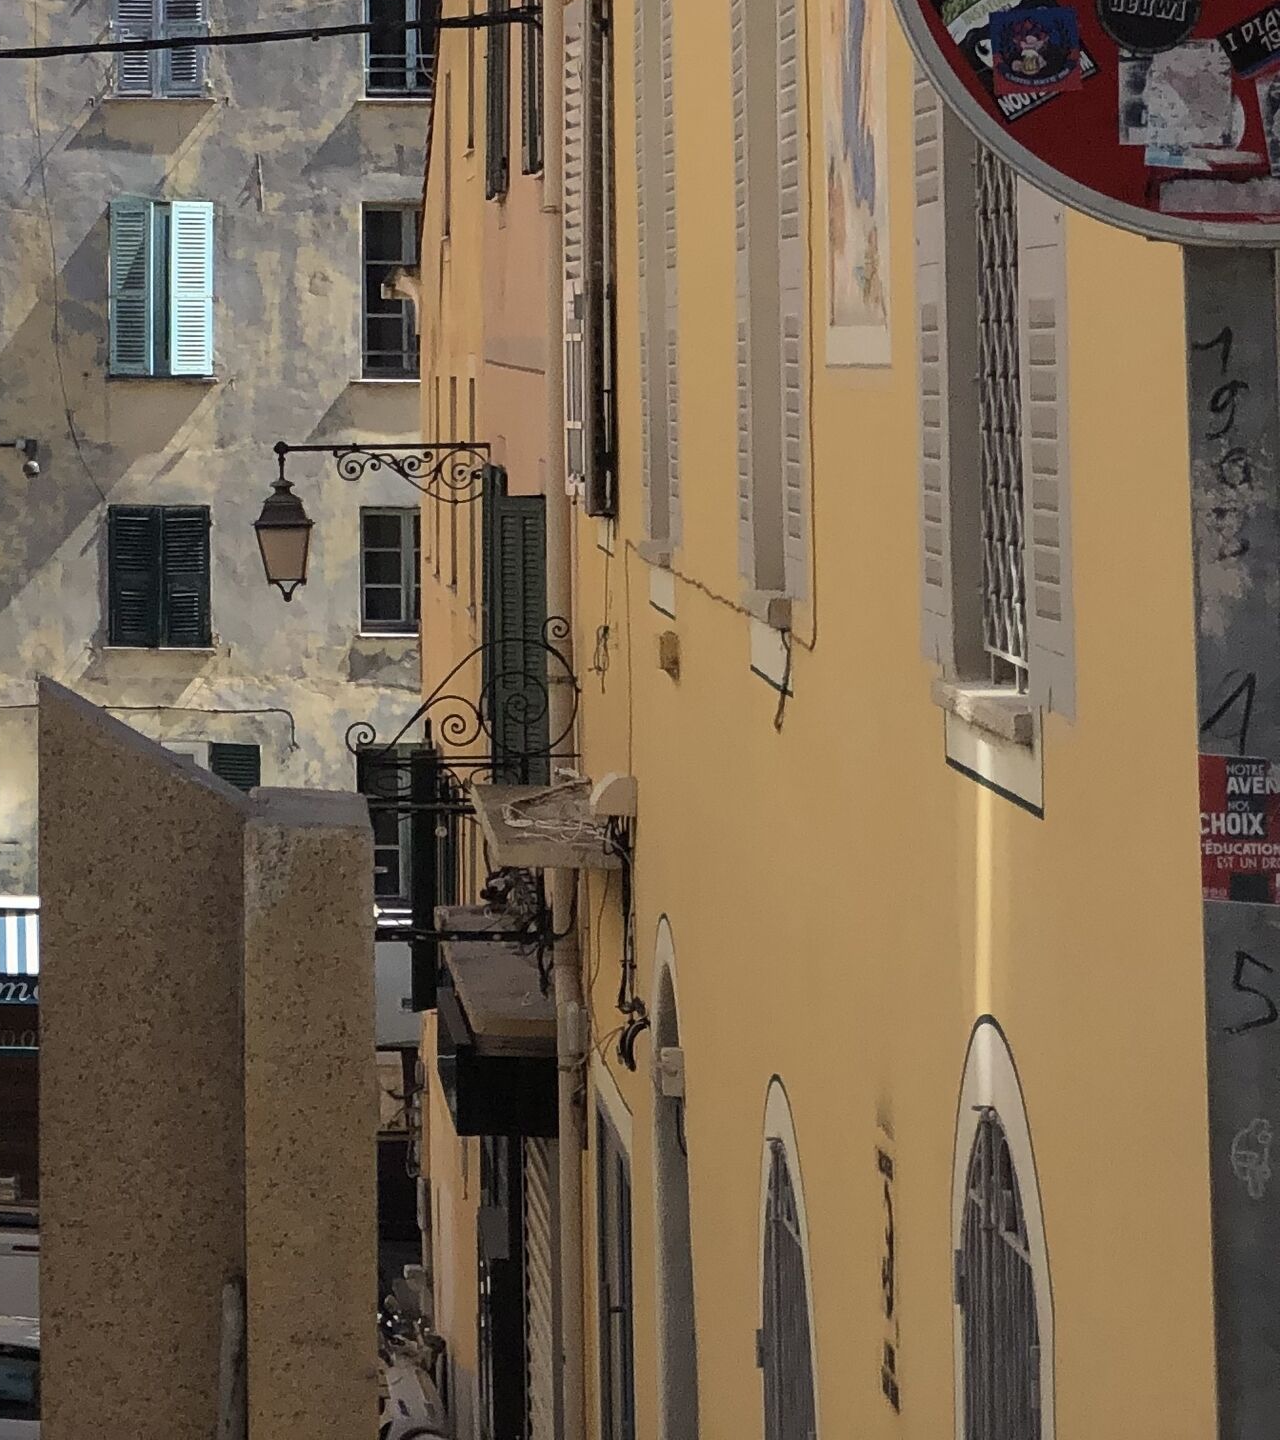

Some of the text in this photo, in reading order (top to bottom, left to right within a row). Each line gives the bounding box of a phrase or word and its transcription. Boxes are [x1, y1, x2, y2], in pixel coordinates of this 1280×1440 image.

[1226, 764, 1264, 777] NOTRE
[1228, 800, 1249, 812] NOS
[1200, 812, 1264, 836] CHOIX
[1217, 856, 1233, 869] EST
[1239, 856, 1257, 869] UN
